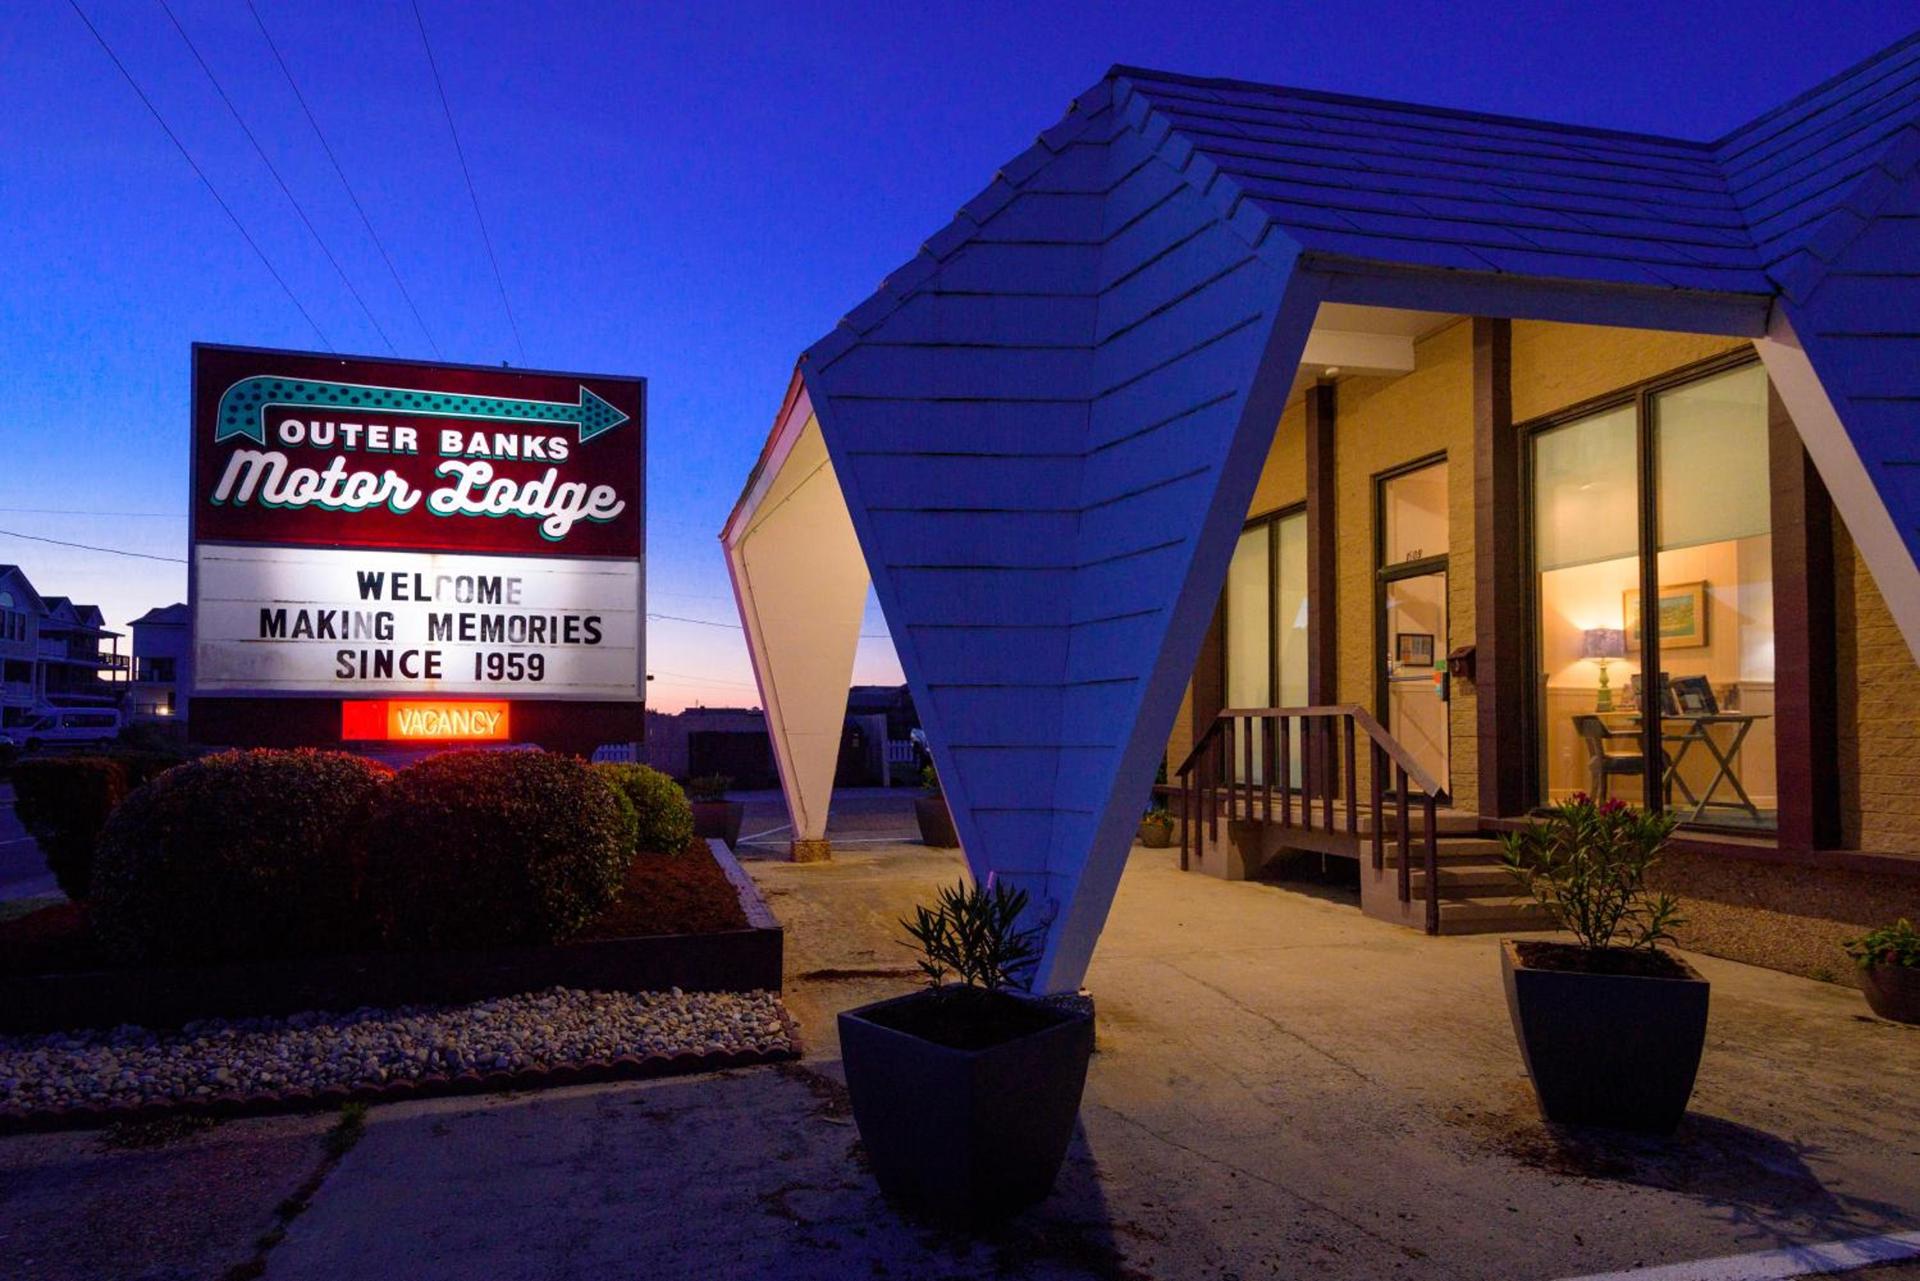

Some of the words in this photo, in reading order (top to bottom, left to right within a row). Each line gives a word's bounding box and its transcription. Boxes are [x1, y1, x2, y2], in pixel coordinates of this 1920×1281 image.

[280, 420, 418, 450] OUTER
[440, 431, 570, 460] BANKS
[214, 449, 421, 513] Motor
[429, 461, 626, 537] Lodge
[357, 571, 523, 604] WELCOME
[260, 608, 394, 641] MAKING
[428, 613, 603, 645] MEMORIES
[335, 649, 443, 680] SINCE
[475, 652, 546, 682] 1959
[397, 709, 502, 736] VACANCY
